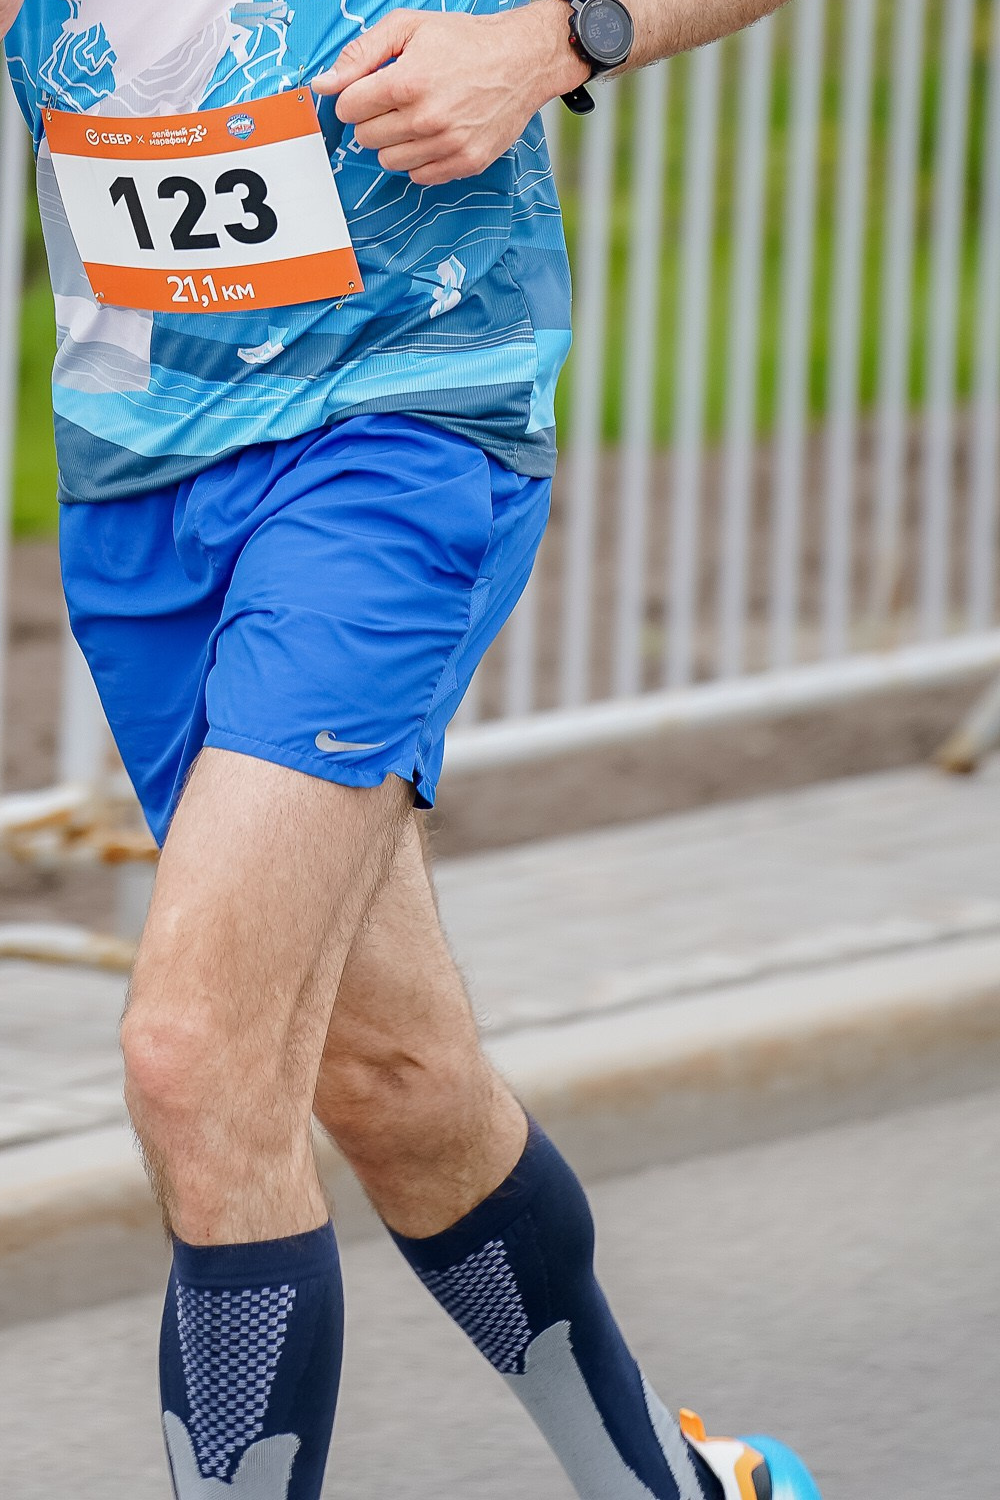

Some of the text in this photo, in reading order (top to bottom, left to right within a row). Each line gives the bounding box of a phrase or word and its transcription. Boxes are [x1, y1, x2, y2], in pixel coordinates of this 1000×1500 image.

[101, 131, 132, 145] СБЕР
[151, 126, 188, 139] зелёный
[149, 135, 187, 147] марафон
[108, 167, 279, 251] 123
[166, 274, 219, 308] 21,1
